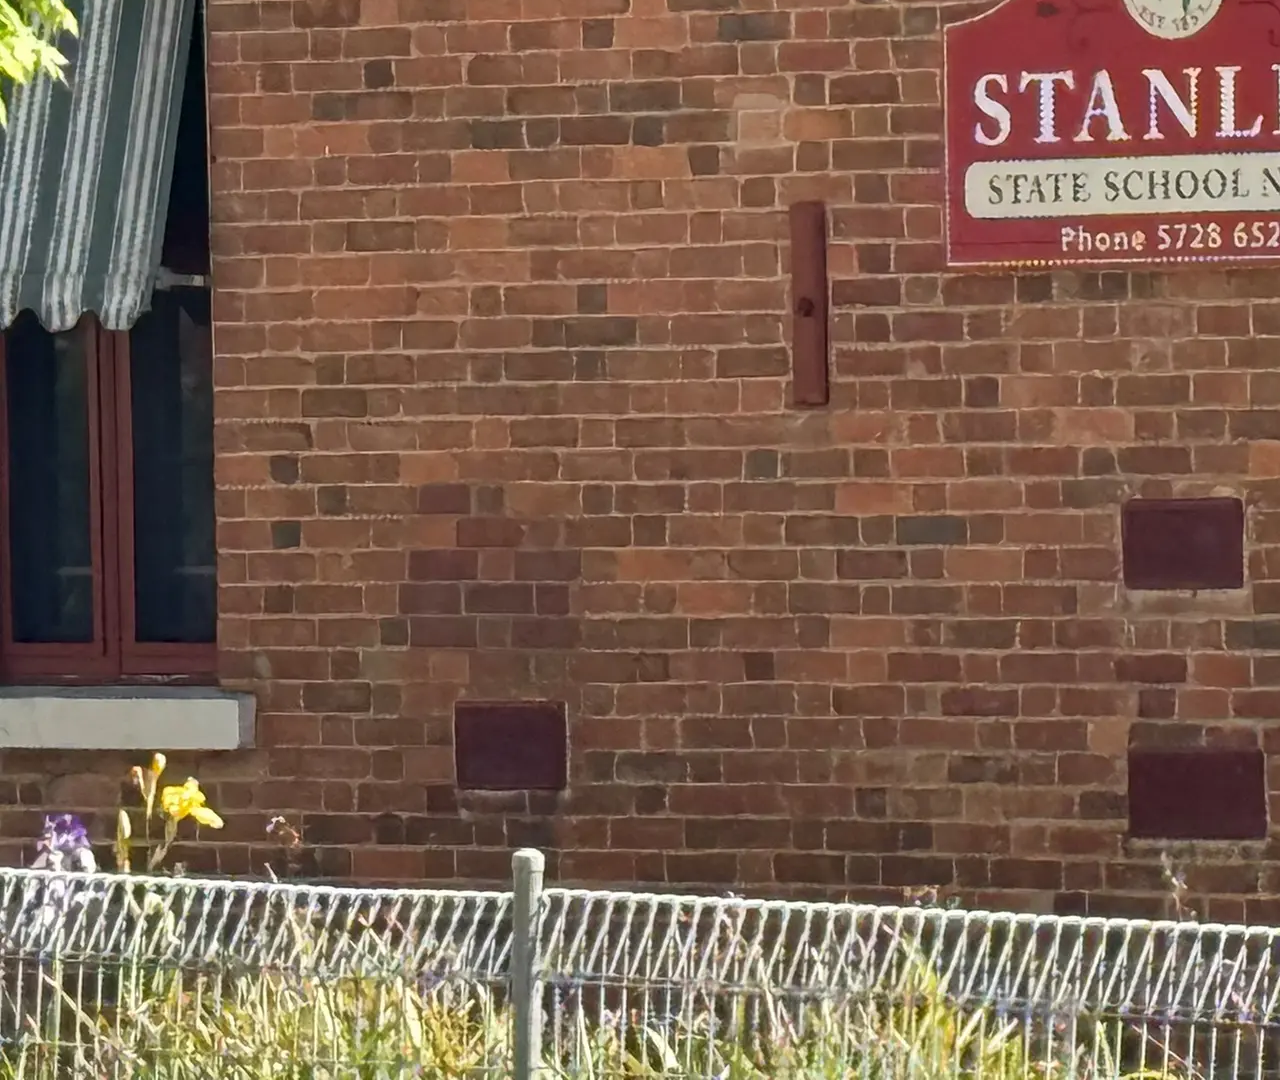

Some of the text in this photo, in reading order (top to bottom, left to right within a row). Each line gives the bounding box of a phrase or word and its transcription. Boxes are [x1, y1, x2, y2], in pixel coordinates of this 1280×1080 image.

[988, 172, 1091, 207] STATE
[1104, 168, 1250, 201] SCHOOL
[1060, 225, 1147, 253] Phone
[1157, 222, 1222, 250] 5728
